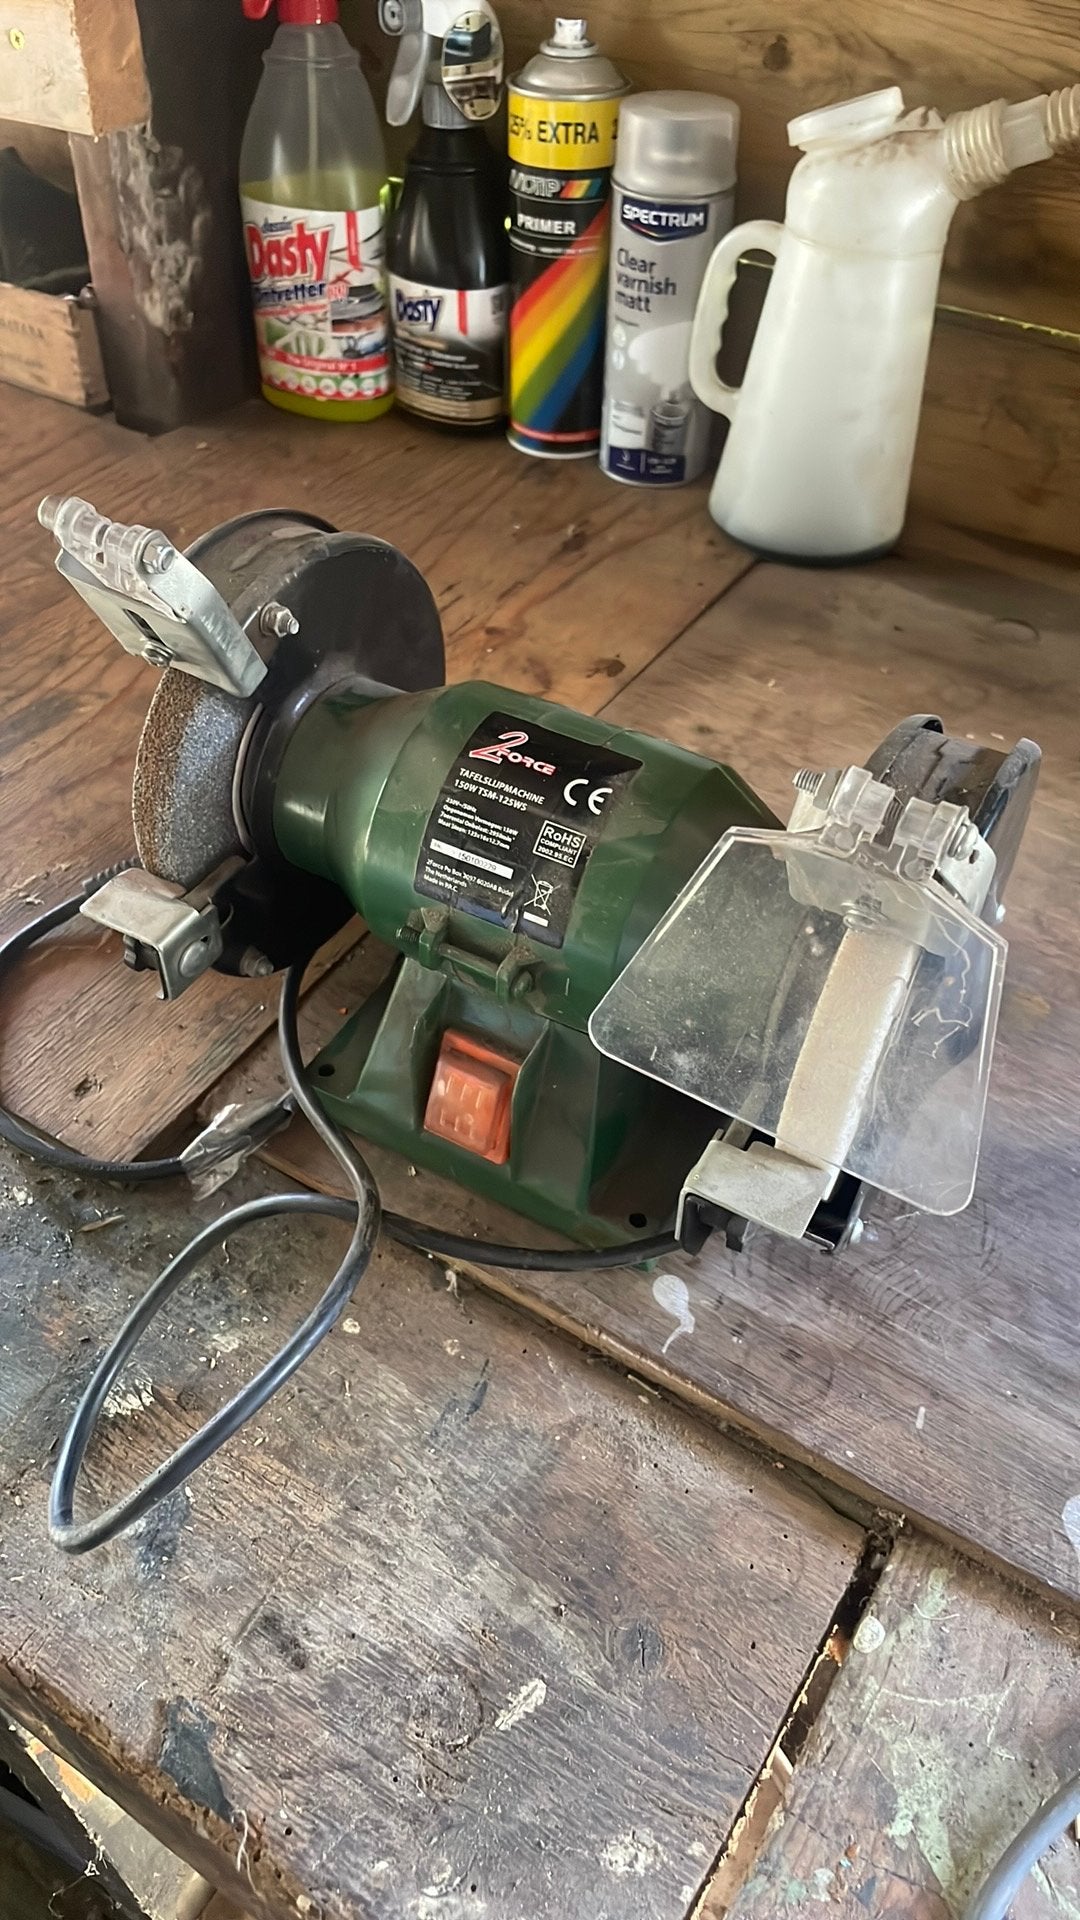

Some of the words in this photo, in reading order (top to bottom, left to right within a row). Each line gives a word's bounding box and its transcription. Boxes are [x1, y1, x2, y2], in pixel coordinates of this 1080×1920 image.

[537, 120, 599, 144] EXTRA
[517, 213, 576, 235] PRIMER
[622, 203, 705, 227] SPECTRUM
[246, 221, 330, 281] Dasty
[617, 248, 657, 273] Clear
[616, 270, 677, 295] varnish
[395, 288, 441, 331] Dasty
[615, 291, 652, 313] matt
[454, 779, 478, 793] 150W
[478, 786, 528, 811] TSM-125WS
[460, 767, 545, 805] TAFELSLIJPMACHINE
[563, 778, 613, 816] CE
[540, 838, 578, 856] COMPLIANT
[543, 826, 581, 848] RoHS
[424, 874, 438, 885] Made
[425, 866, 435, 875] The
[435, 869, 467, 888] Netherlands
